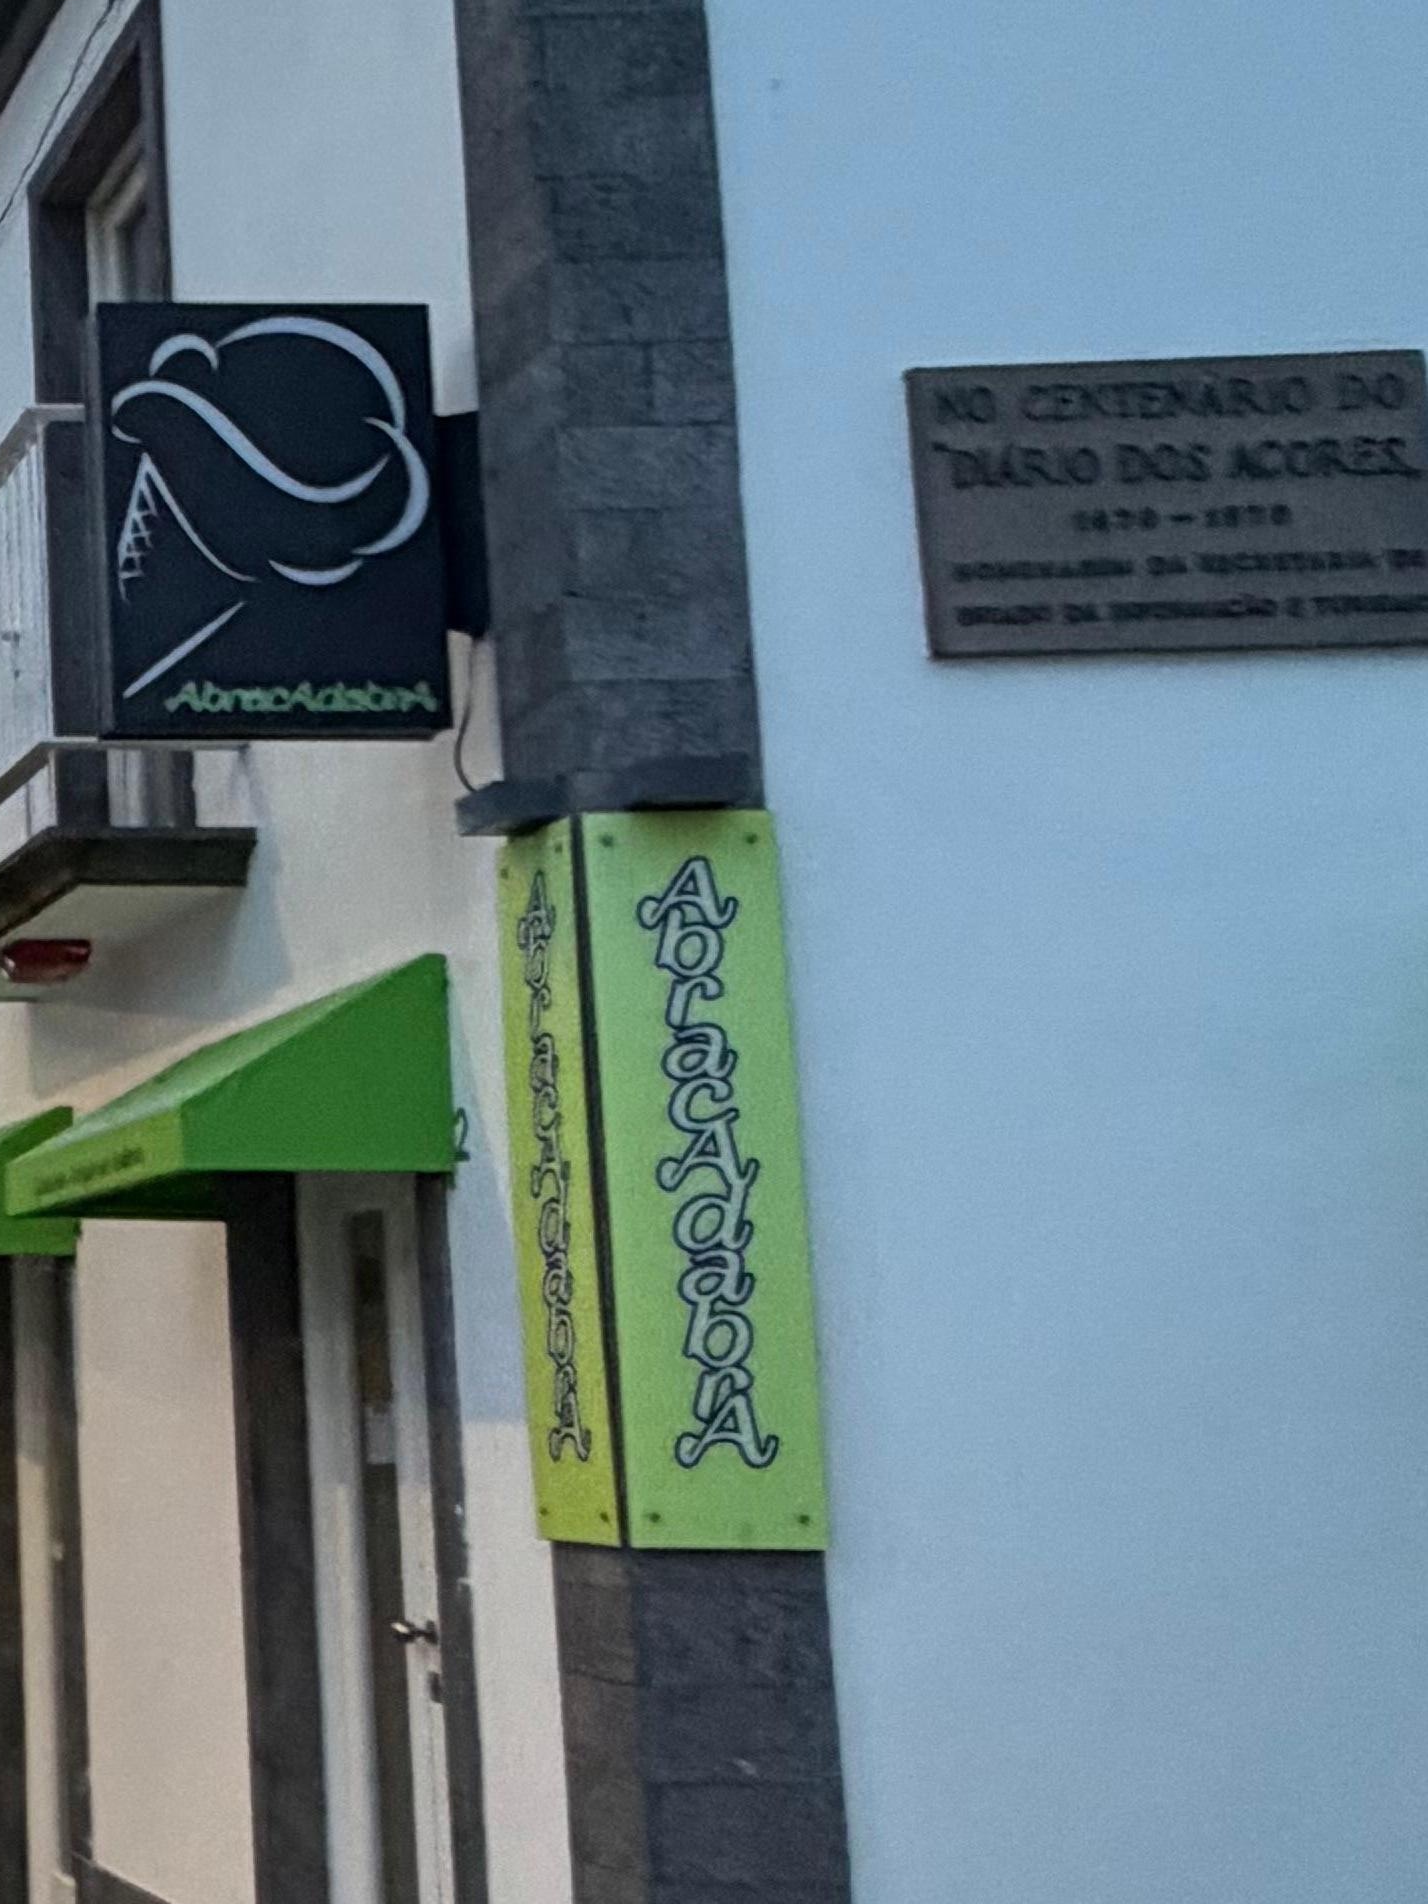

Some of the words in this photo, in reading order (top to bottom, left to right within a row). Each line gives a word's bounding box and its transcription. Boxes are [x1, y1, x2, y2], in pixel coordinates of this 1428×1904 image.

[1334, 371, 1406, 412] DO
[1115, 441, 1212, 484] DOS
[636, 856, 779, 1470] AbracAdabrA
